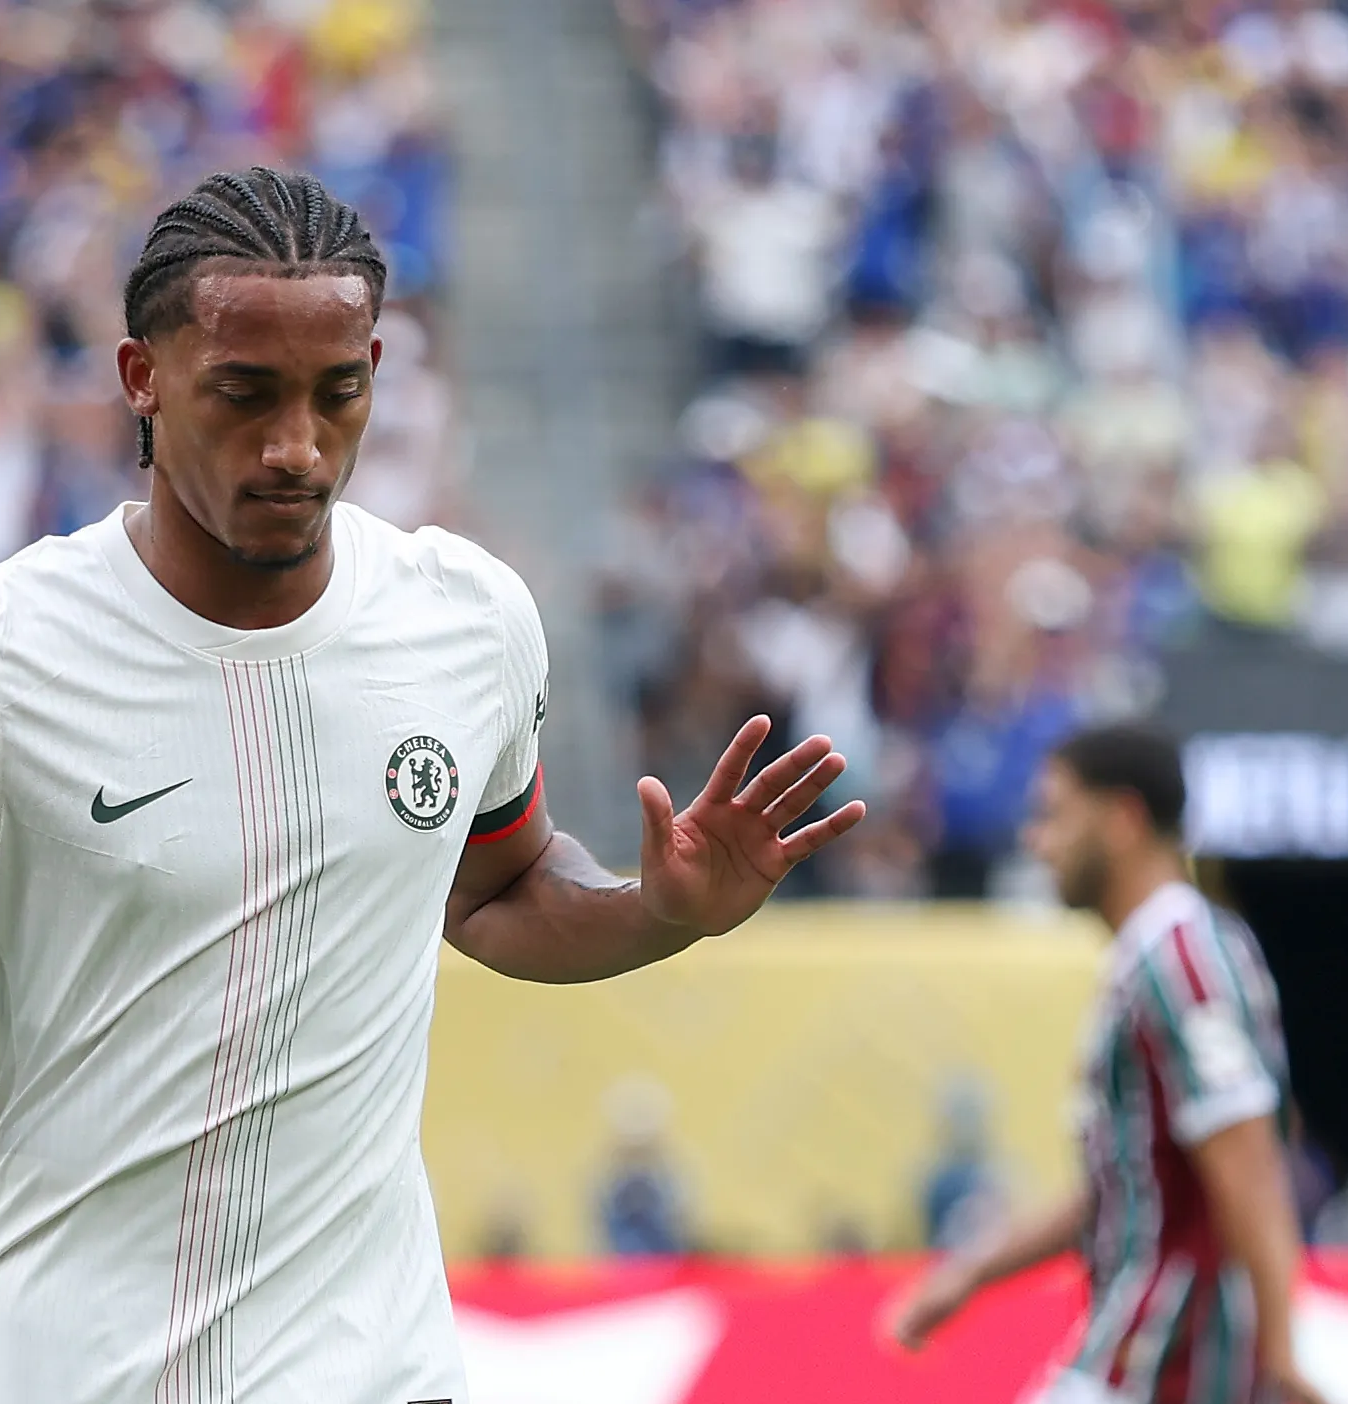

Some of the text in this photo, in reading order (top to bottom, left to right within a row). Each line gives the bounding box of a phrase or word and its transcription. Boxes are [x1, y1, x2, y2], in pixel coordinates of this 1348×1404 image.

[396, 737, 446, 758] CHELSEA
[400, 808, 450, 827] FOOTBALL CLUB
